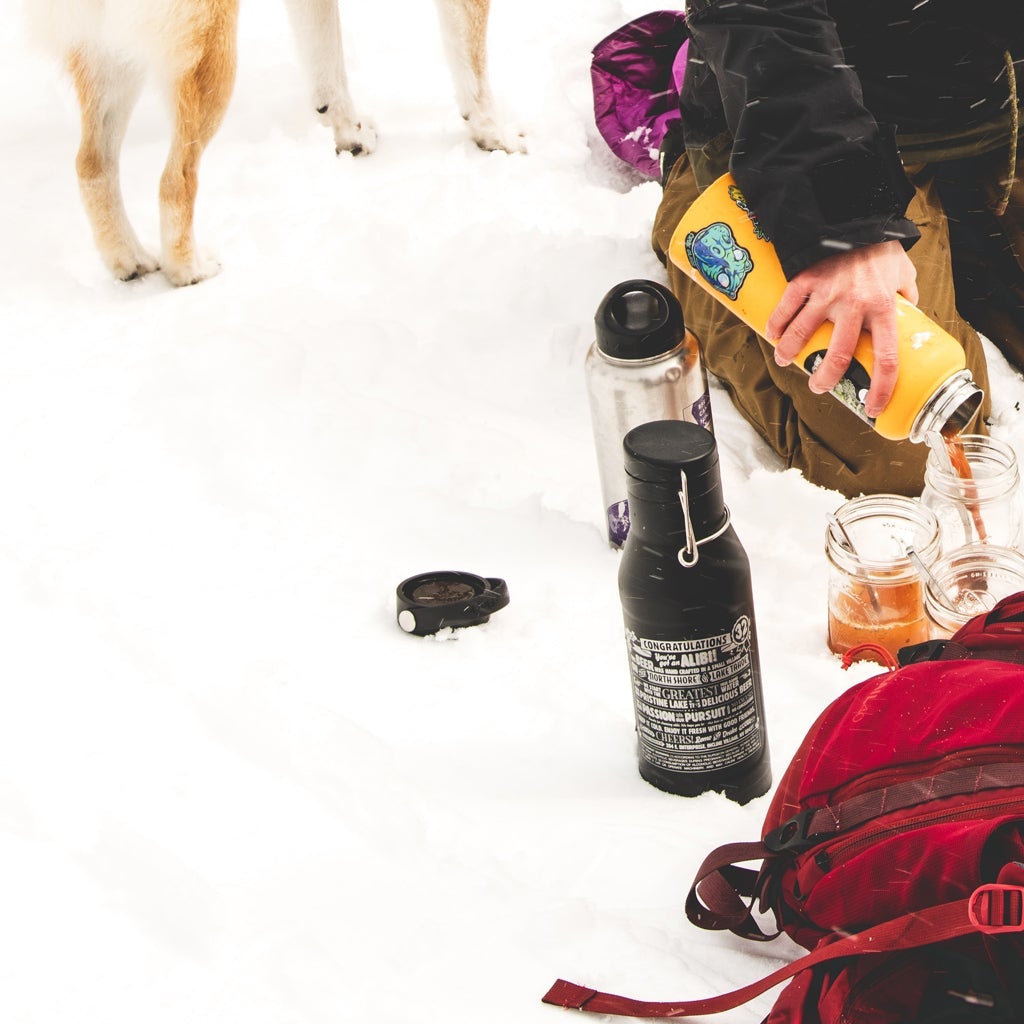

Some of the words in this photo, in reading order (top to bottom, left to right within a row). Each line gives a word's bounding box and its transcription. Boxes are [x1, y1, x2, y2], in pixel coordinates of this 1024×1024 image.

[735, 619, 748, 641] 32
[643, 636, 727, 651] CONGRATULATIONS
[680, 649, 717, 667] ALIBI!
[649, 672, 672, 683] NORTH
[673, 675, 697, 684] SHORE
[711, 668, 729, 679] LAKE
[661, 685, 718, 699] GREATEST
[701, 688, 738, 707] DELICIOUS
[739, 678, 752, 694] BEER
[669, 699, 688, 709] LAKE
[684, 706, 725, 722] PURSUIT
[688, 727, 707, 735] FRESH
[707, 723, 723, 732] WITH
[723, 718, 738, 727] GOOD
[655, 731, 694, 744] CHEERS!
